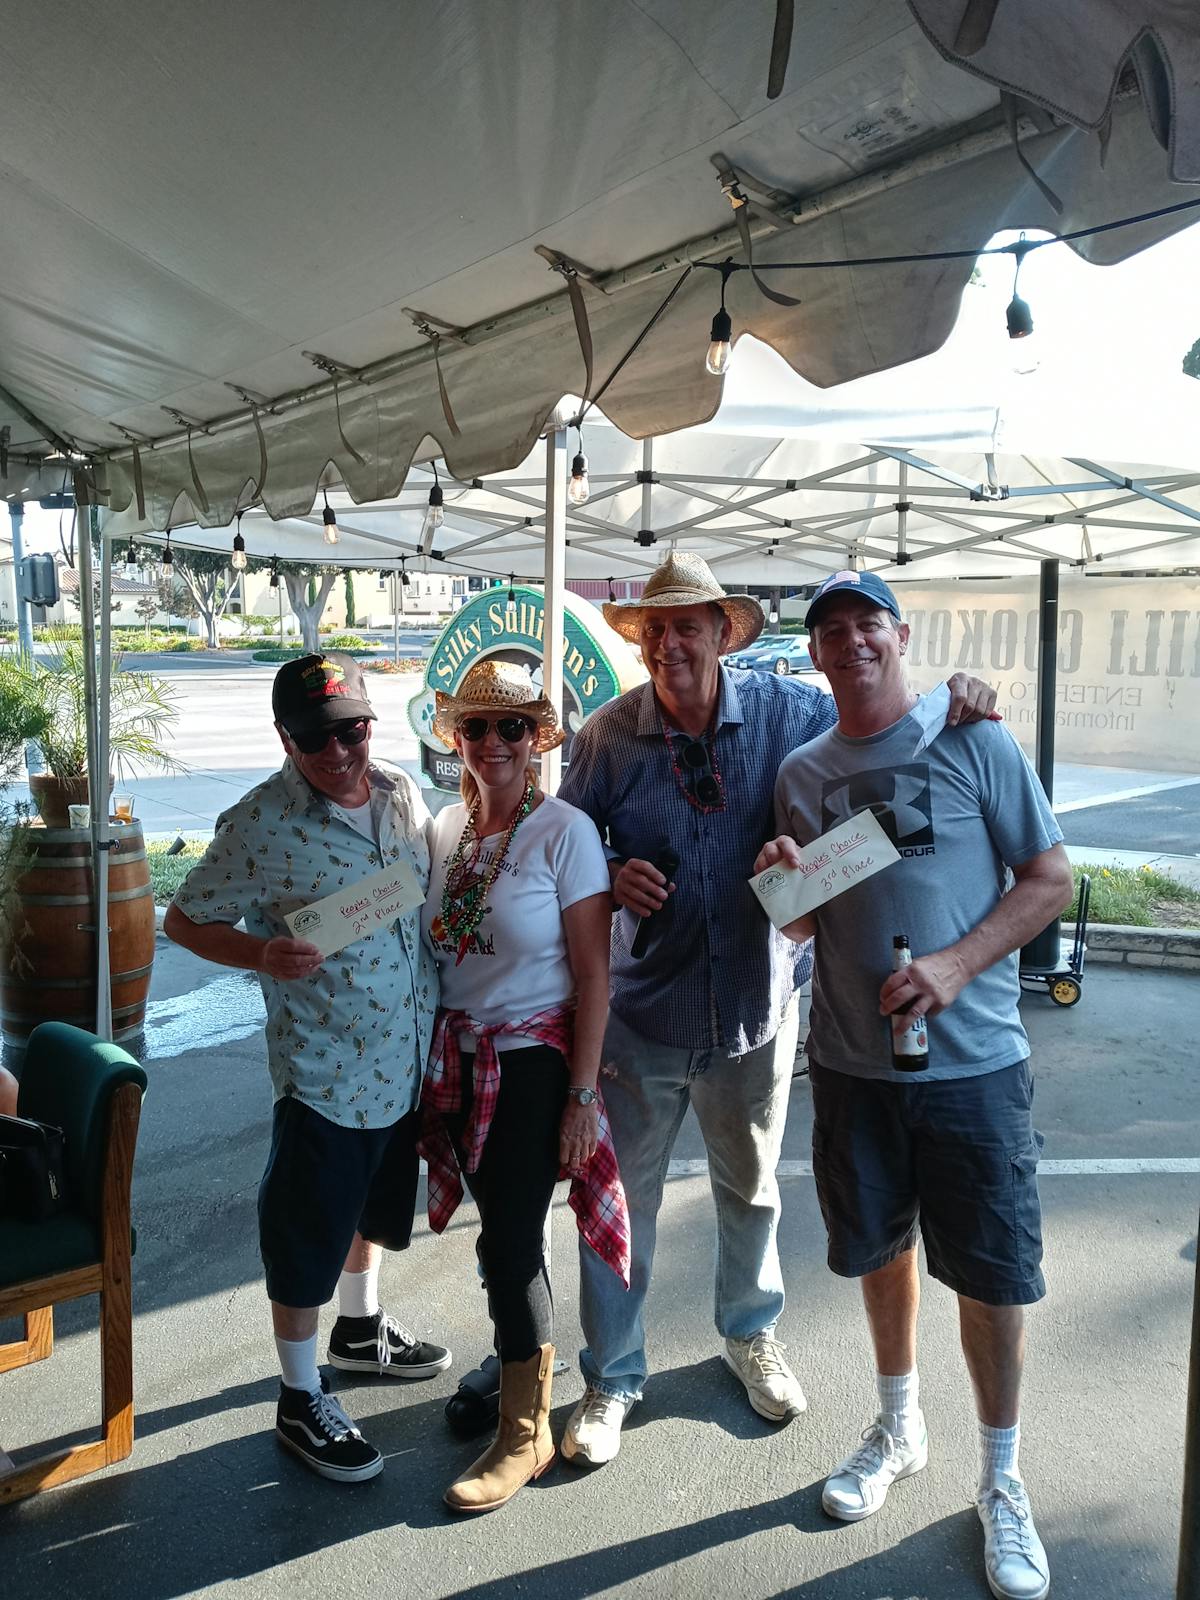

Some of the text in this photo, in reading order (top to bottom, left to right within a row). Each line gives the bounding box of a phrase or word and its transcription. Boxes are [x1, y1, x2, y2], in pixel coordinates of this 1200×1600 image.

[436, 601, 599, 696] Silky Sullian's
[830, 831, 865, 855] Choice
[372, 879, 401, 899] Choice
[820, 856, 875, 892] 3rd Place
[352, 901, 404, 935] 2nd Place
